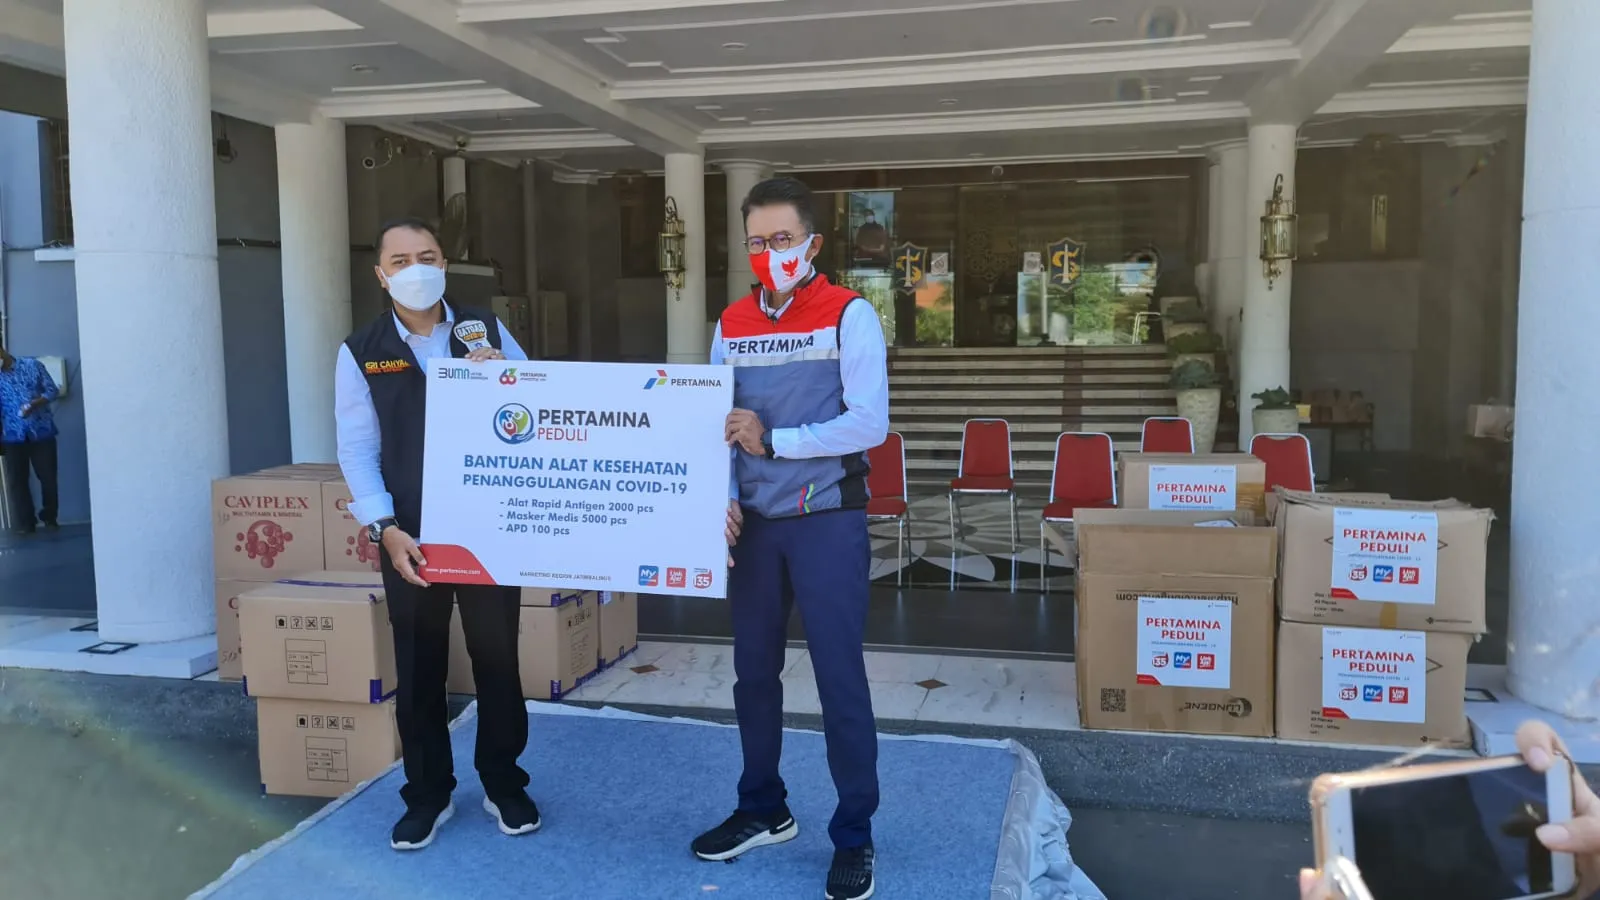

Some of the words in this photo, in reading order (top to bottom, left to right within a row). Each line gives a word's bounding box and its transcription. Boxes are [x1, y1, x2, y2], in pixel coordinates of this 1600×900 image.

[729, 335, 814, 354] PERTAMINA
[671, 378, 722, 388] PERTAMINA
[538, 409, 651, 428] PERTAMINA
[538, 427, 588, 442] PEDULI
[464, 455, 544, 471] BANTUAN
[548, 457, 589, 472] ALAT
[593, 459, 688, 476] KESEHATAN
[463, 475, 611, 492] PENANGGULANGAN
[616, 480, 688, 494] COVID-19
[1157, 483, 1227, 493] PERTAMINA
[224, 495, 310, 509] CAVIPLEX
[507, 498, 529, 508] Alat
[531, 499, 562, 511] Rapid
[564, 500, 606, 512] Antigen
[608, 501, 634, 512] 2000
[637, 504, 654, 515] pcs
[1171, 495, 1212, 504] PEDULI
[507, 511, 546, 522] Masker
[548, 512, 579, 523] Medis
[582, 513, 607, 525] 5000
[610, 516, 628, 527] pcs
[506, 524, 529, 534] APD
[531, 524, 549, 535] 100
[552, 527, 571, 537] pcs
[1343, 528, 1427, 542] PERTAMINA
[1360, 542, 1409, 554] PEDULI
[1146, 617, 1222, 629] PERTAMINA
[1161, 630, 1205, 641] PEDULI
[1332, 648, 1415, 663] PERTAMINA
[1349, 662, 1398, 674] PEDULI
